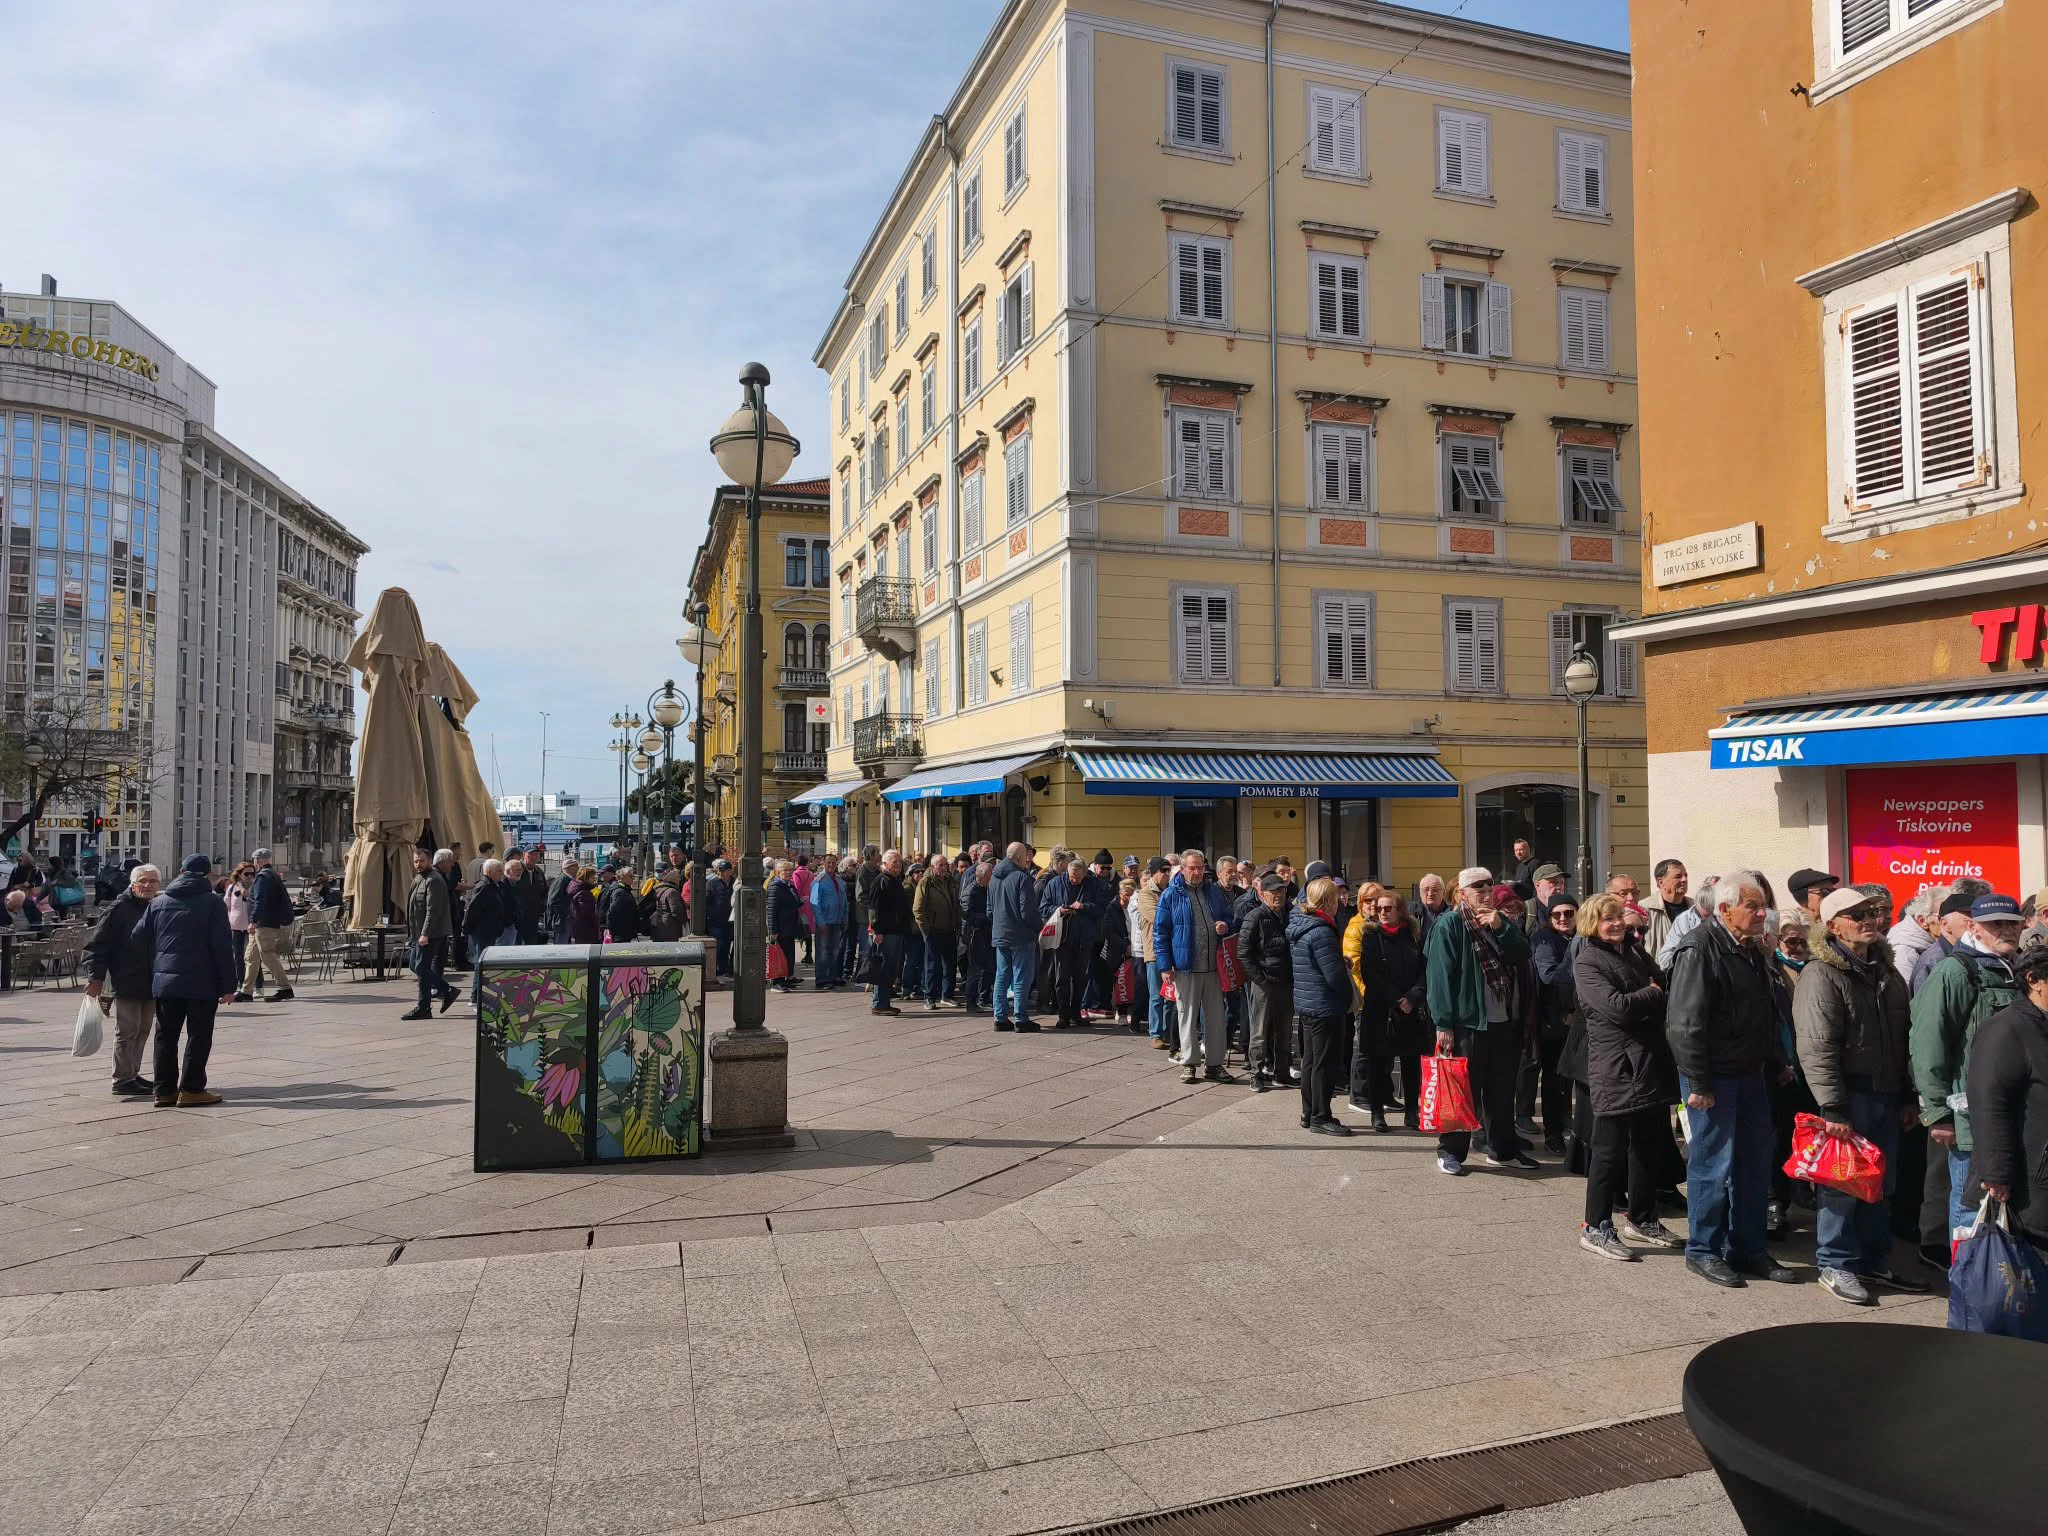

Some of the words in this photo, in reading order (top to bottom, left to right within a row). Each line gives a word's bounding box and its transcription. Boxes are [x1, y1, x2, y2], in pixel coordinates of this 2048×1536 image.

[0, 322, 160, 382] EUROHERC
[1664, 548, 1682, 560] TRG
[1686, 544, 1699, 555] 128
[1702, 533, 1743, 551] BRIGADE
[1663, 559, 1706, 577] HRVATSKE
[1710, 550, 1745, 565] VOJSKE
[1971, 604, 2048, 664] TI
[1728, 737, 1806, 763] TISAK
[1240, 786, 1295, 797] POMMERY
[1299, 787, 1320, 797] BAR
[1883, 799, 1985, 814] Newspapers
[1896, 817, 1973, 833] Tiskovine
[1889, 859, 1927, 875] Cold
[1931, 860, 1983, 877] drinks
